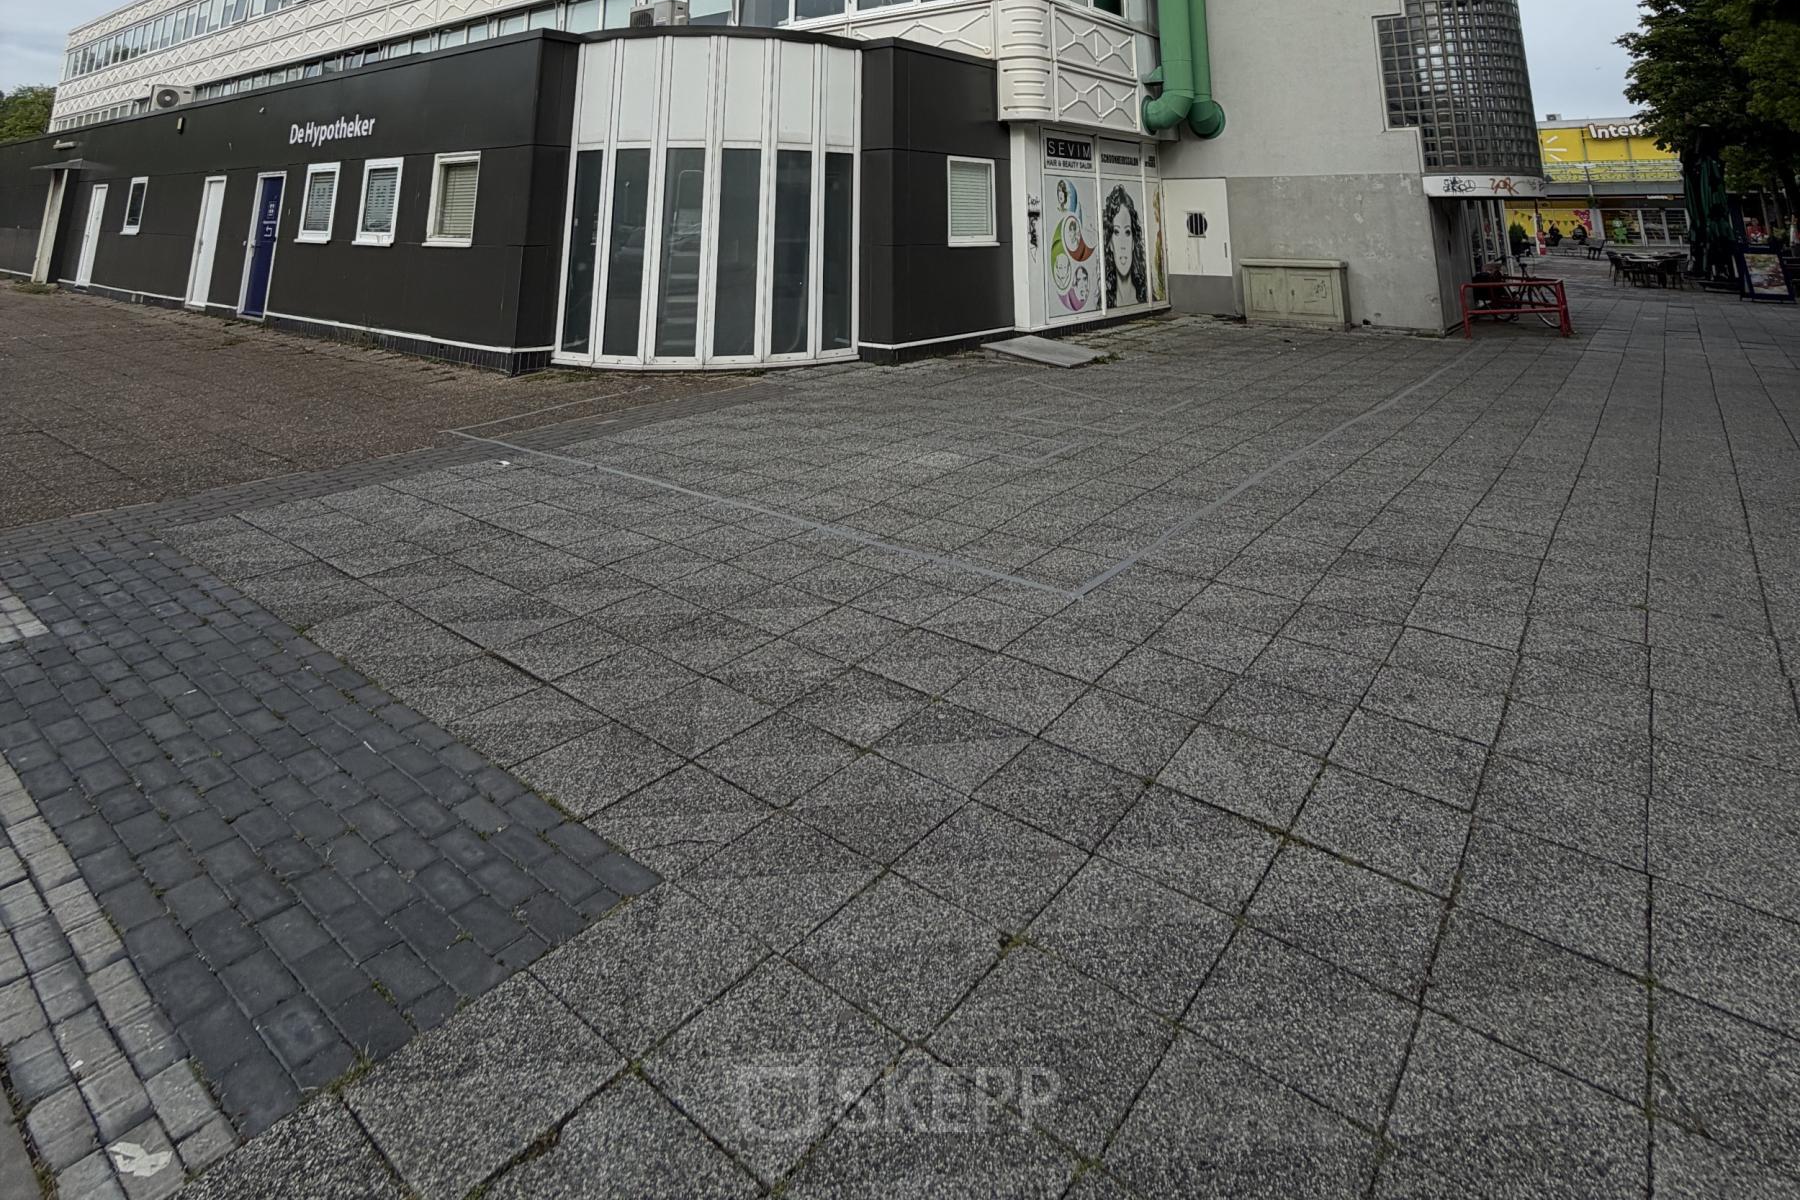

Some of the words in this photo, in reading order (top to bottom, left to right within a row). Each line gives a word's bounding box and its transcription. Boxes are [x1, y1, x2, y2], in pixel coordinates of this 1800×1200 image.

[304, 113, 376, 148] Hypotheker
[1048, 141, 1091, 158] SEVIM
[1047, 159, 1057, 167] HAIR
[1062, 160, 1079, 169] BEAUTY
[1079, 161, 1092, 170] SALON
